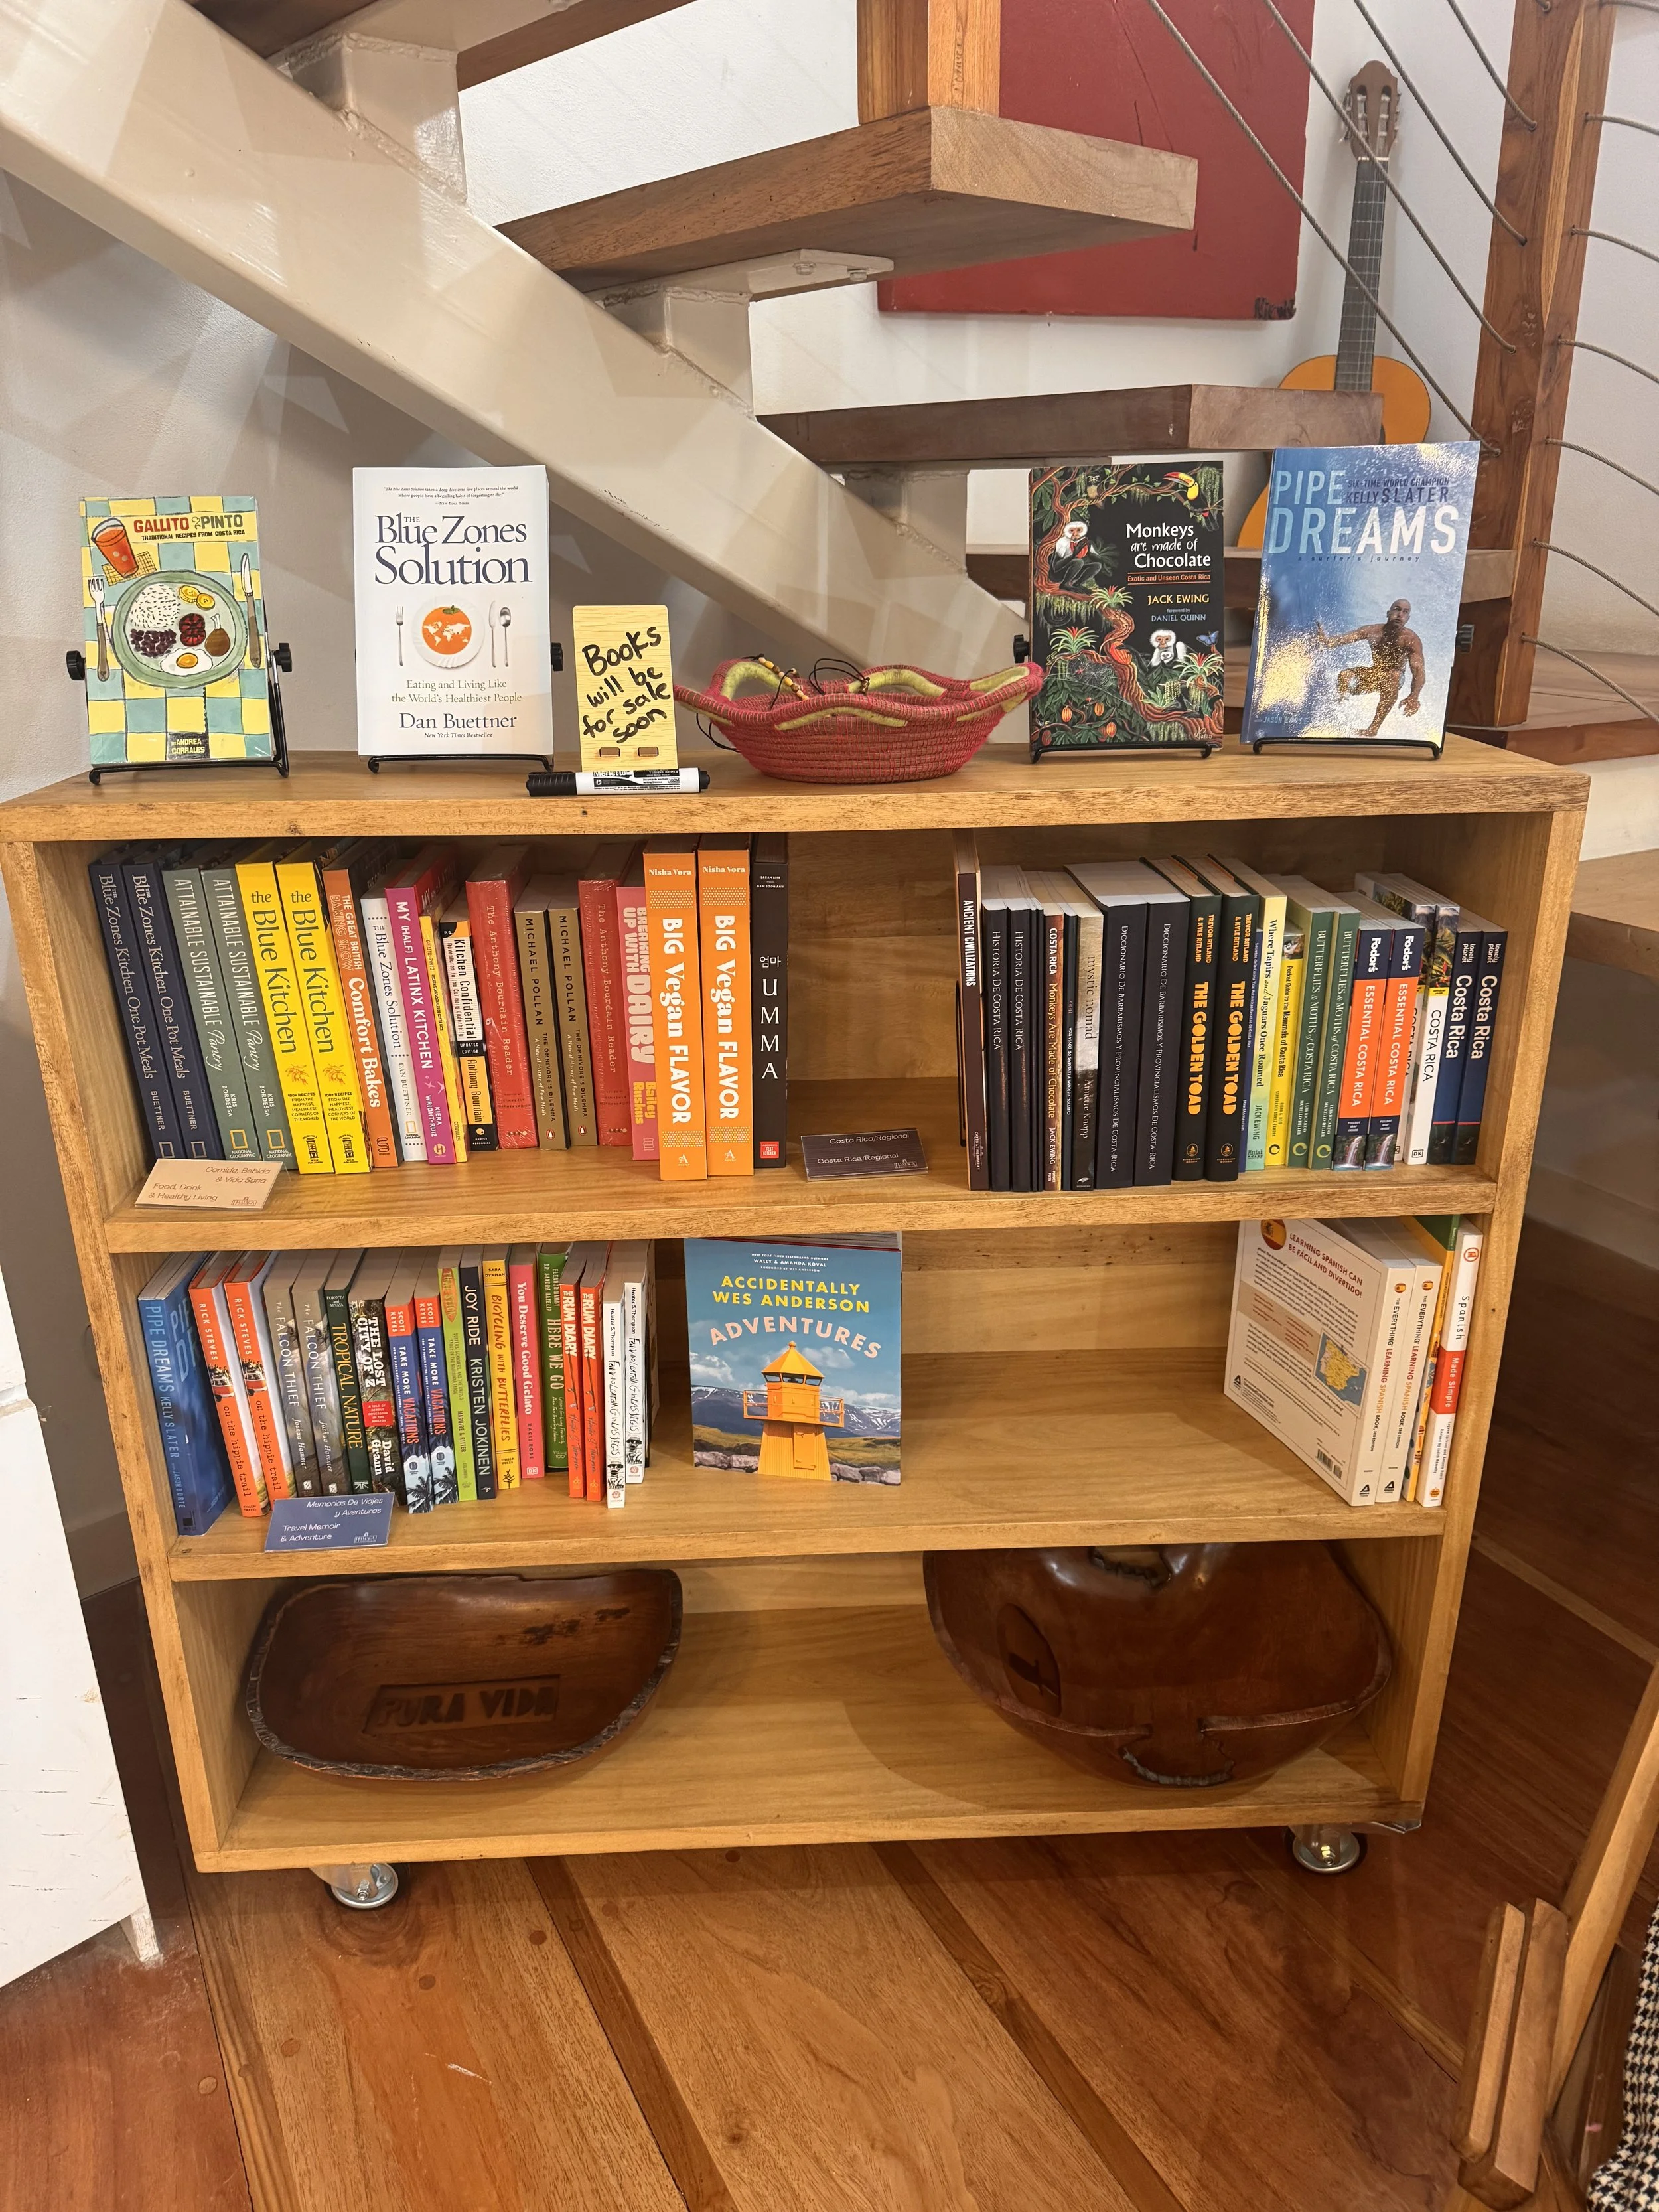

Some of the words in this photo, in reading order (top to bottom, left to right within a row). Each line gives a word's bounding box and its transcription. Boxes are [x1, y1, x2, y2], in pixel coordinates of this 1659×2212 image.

[1273, 470, 1346, 505] PIPE
[1346, 491, 1380, 504] KELLY
[1382, 486, 1449, 504] SLATER
[1348, 479, 1381, 488] SIX-TIME
[1384, 479, 1408, 487] WORLD
[1411, 477, 1449, 486] CHAMPION
[133, 516, 190, 533] GALLITO
[201, 514, 244, 529] PINTO
[374, 512, 438, 544] Blue
[441, 516, 527, 544] Zones
[1125, 522, 1194, 539] Monkeys
[1269, 506, 1459, 555] DREAMS
[1131, 542, 1147, 552] are
[1151, 538, 1182, 552] made
[1187, 538, 1198, 551] of
[1134, 552, 1211, 569] Chocolate
[375, 542, 533, 585] Solution
[1147, 595, 1173, 605] JACK
[1176, 594, 1210, 603] EWING
[582, 626, 662, 676] Books
[392, 693, 406, 702] the
[408, 694, 443, 703] World's
[446, 692, 491, 703] Healthiest
[494, 692, 522, 704] People
[407, 680, 437, 691] Eating
[438, 680, 455, 689] and
[458, 680, 486, 690] Living
[488, 678, 507, 688] Like
[586, 675, 624, 707] will
[628, 666, 663, 686] be
[399, 713, 438, 729] Dan
[443, 713, 518, 729] Buettner
[582, 708, 614, 738] for
[622, 681, 671, 715] sale
[613, 708, 668, 743] soon
[176, 737, 202, 746] ANDREA
[212, 879, 243, 946] ATTAINABLE
[251, 891, 271, 903] the
[623, 907, 637, 928] UP
[963, 900, 974, 935] ANCIENT
[1266, 919, 1277, 949] Where
[253, 910, 279, 961] Blue
[624, 932, 640, 973] WITH
[662, 919, 684, 954] BIG
[454, 940, 467, 976] Kitchen
[760, 956, 781, 968] 엄마
[964, 937, 976, 986] CIVILIZATIONS
[992, 931, 1001, 976] HISTORIA
[1264, 950, 1275, 978] Tapirs
[1368, 937, 1381, 973] Fodor's
[229, 951, 259, 1026] SUSTAINABLE
[525, 919, 538, 972] MICHAEL
[532, 978, 543, 1025] POLLAN
[993, 979, 1001, 992] DE
[1262, 980, 1273, 996] and
[265, 968, 297, 1053] Kitchen
[459, 980, 476, 1039] Confidential
[660, 962, 685, 1038] Vegan
[993, 994, 1001, 1025] COSTA
[1194, 981, 1209, 1009] THE
[1260, 995, 1271, 1029] Jaguars
[1451, 975, 1473, 1022] Costa
[626, 975, 655, 1063] DAIRY
[1360, 986, 1376, 1041] ESSENTIAL
[243, 1030, 263, 1071] Pantry
[1190, 1011, 1207, 1072] GOLDEN
[1259, 1031, 1267, 1051] Once
[1445, 1024, 1465, 1059] Rica
[1256, 1053, 1266, 1087] Roamed
[1355, 1043, 1368, 1078] COSTA
[669, 1045, 691, 1124] FLAVOR
[1188, 1074, 1203, 1115] TOAD
[1351, 1082, 1364, 1107] RICA
[856, 1132, 909, 1143] Rica/Regional
[1289, 1232, 1321, 1257] LEARNING
[1321, 1253, 1348, 1276] SPANISH
[1348, 1271, 1363, 1286] CAN
[464, 1286, 478, 1311] JOY
[712, 1290, 752, 1305] WES
[760, 1295, 870, 1313] ANDERSON
[721, 1275, 861, 1295] ACCIDENTALLY
[563, 1296, 575, 1321] RUM
[1455, 1295, 1470, 1340] Spanish
[199, 1303, 210, 1324] RICK
[205, 1328, 218, 1360] STEVES
[368, 1317, 381, 1347] THE
[467, 1316, 481, 1346] RIDE
[547, 1319, 562, 1349] HERE
[564, 1323, 577, 1357] DIARY
[709, 1315, 882, 1359] ADVENTURES
[372, 1351, 386, 1387] LOST
[399, 1346, 408, 1367] TAKE
[549, 1353, 563, 1369] WE
[1449, 1357, 1459, 1378] Made
[401, 1370, 411, 1394] MORE
[470, 1358, 486, 1414] KRISTEN
[549, 1375, 564, 1390] GO
[1445, 1381, 1456, 1408] Simple
[403, 1398, 419, 1445] VACATIONS
[223, 1406, 231, 1416] on
[231, 1439, 244, 1469] hippie
[240, 1473, 251, 1497] trail
[474, 1420, 490, 1475] JOKINEN
[479, 1686, 555, 1719] VIDA
